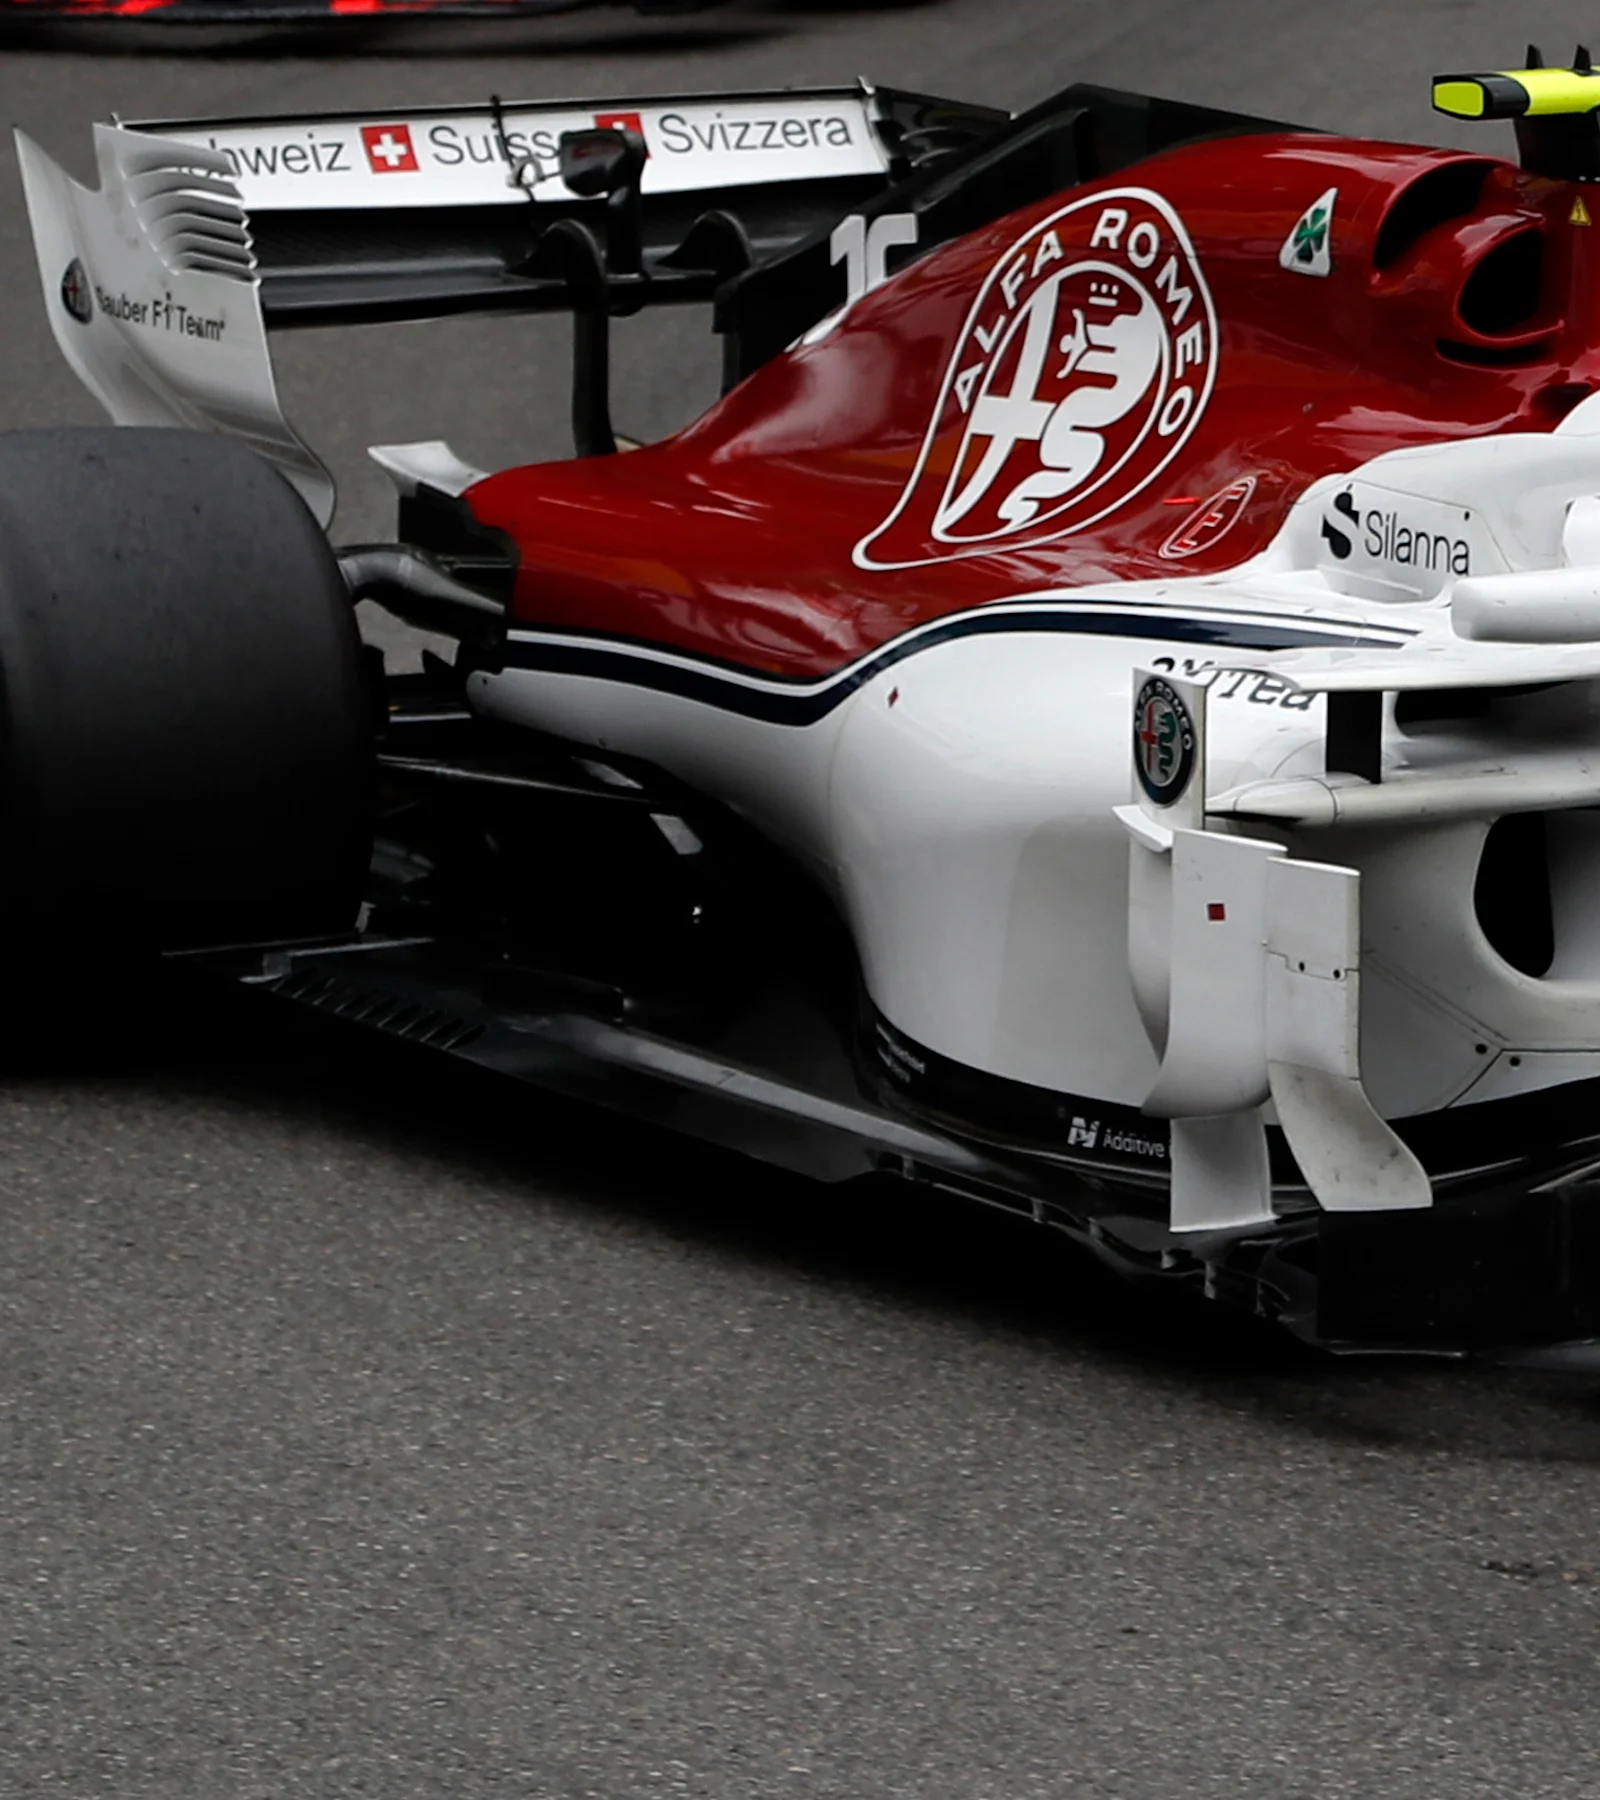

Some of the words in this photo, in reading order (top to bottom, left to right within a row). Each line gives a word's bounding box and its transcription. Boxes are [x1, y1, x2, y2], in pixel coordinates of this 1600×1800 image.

[428, 124, 560, 166] Suiss
[657, 112, 854, 154] Svizzera
[953, 229, 1065, 414] ALFA
[1088, 208, 1202, 437] ROMEO
[1364, 510, 1470, 577] Silanna
[1102, 1128, 1166, 1159] Additive
